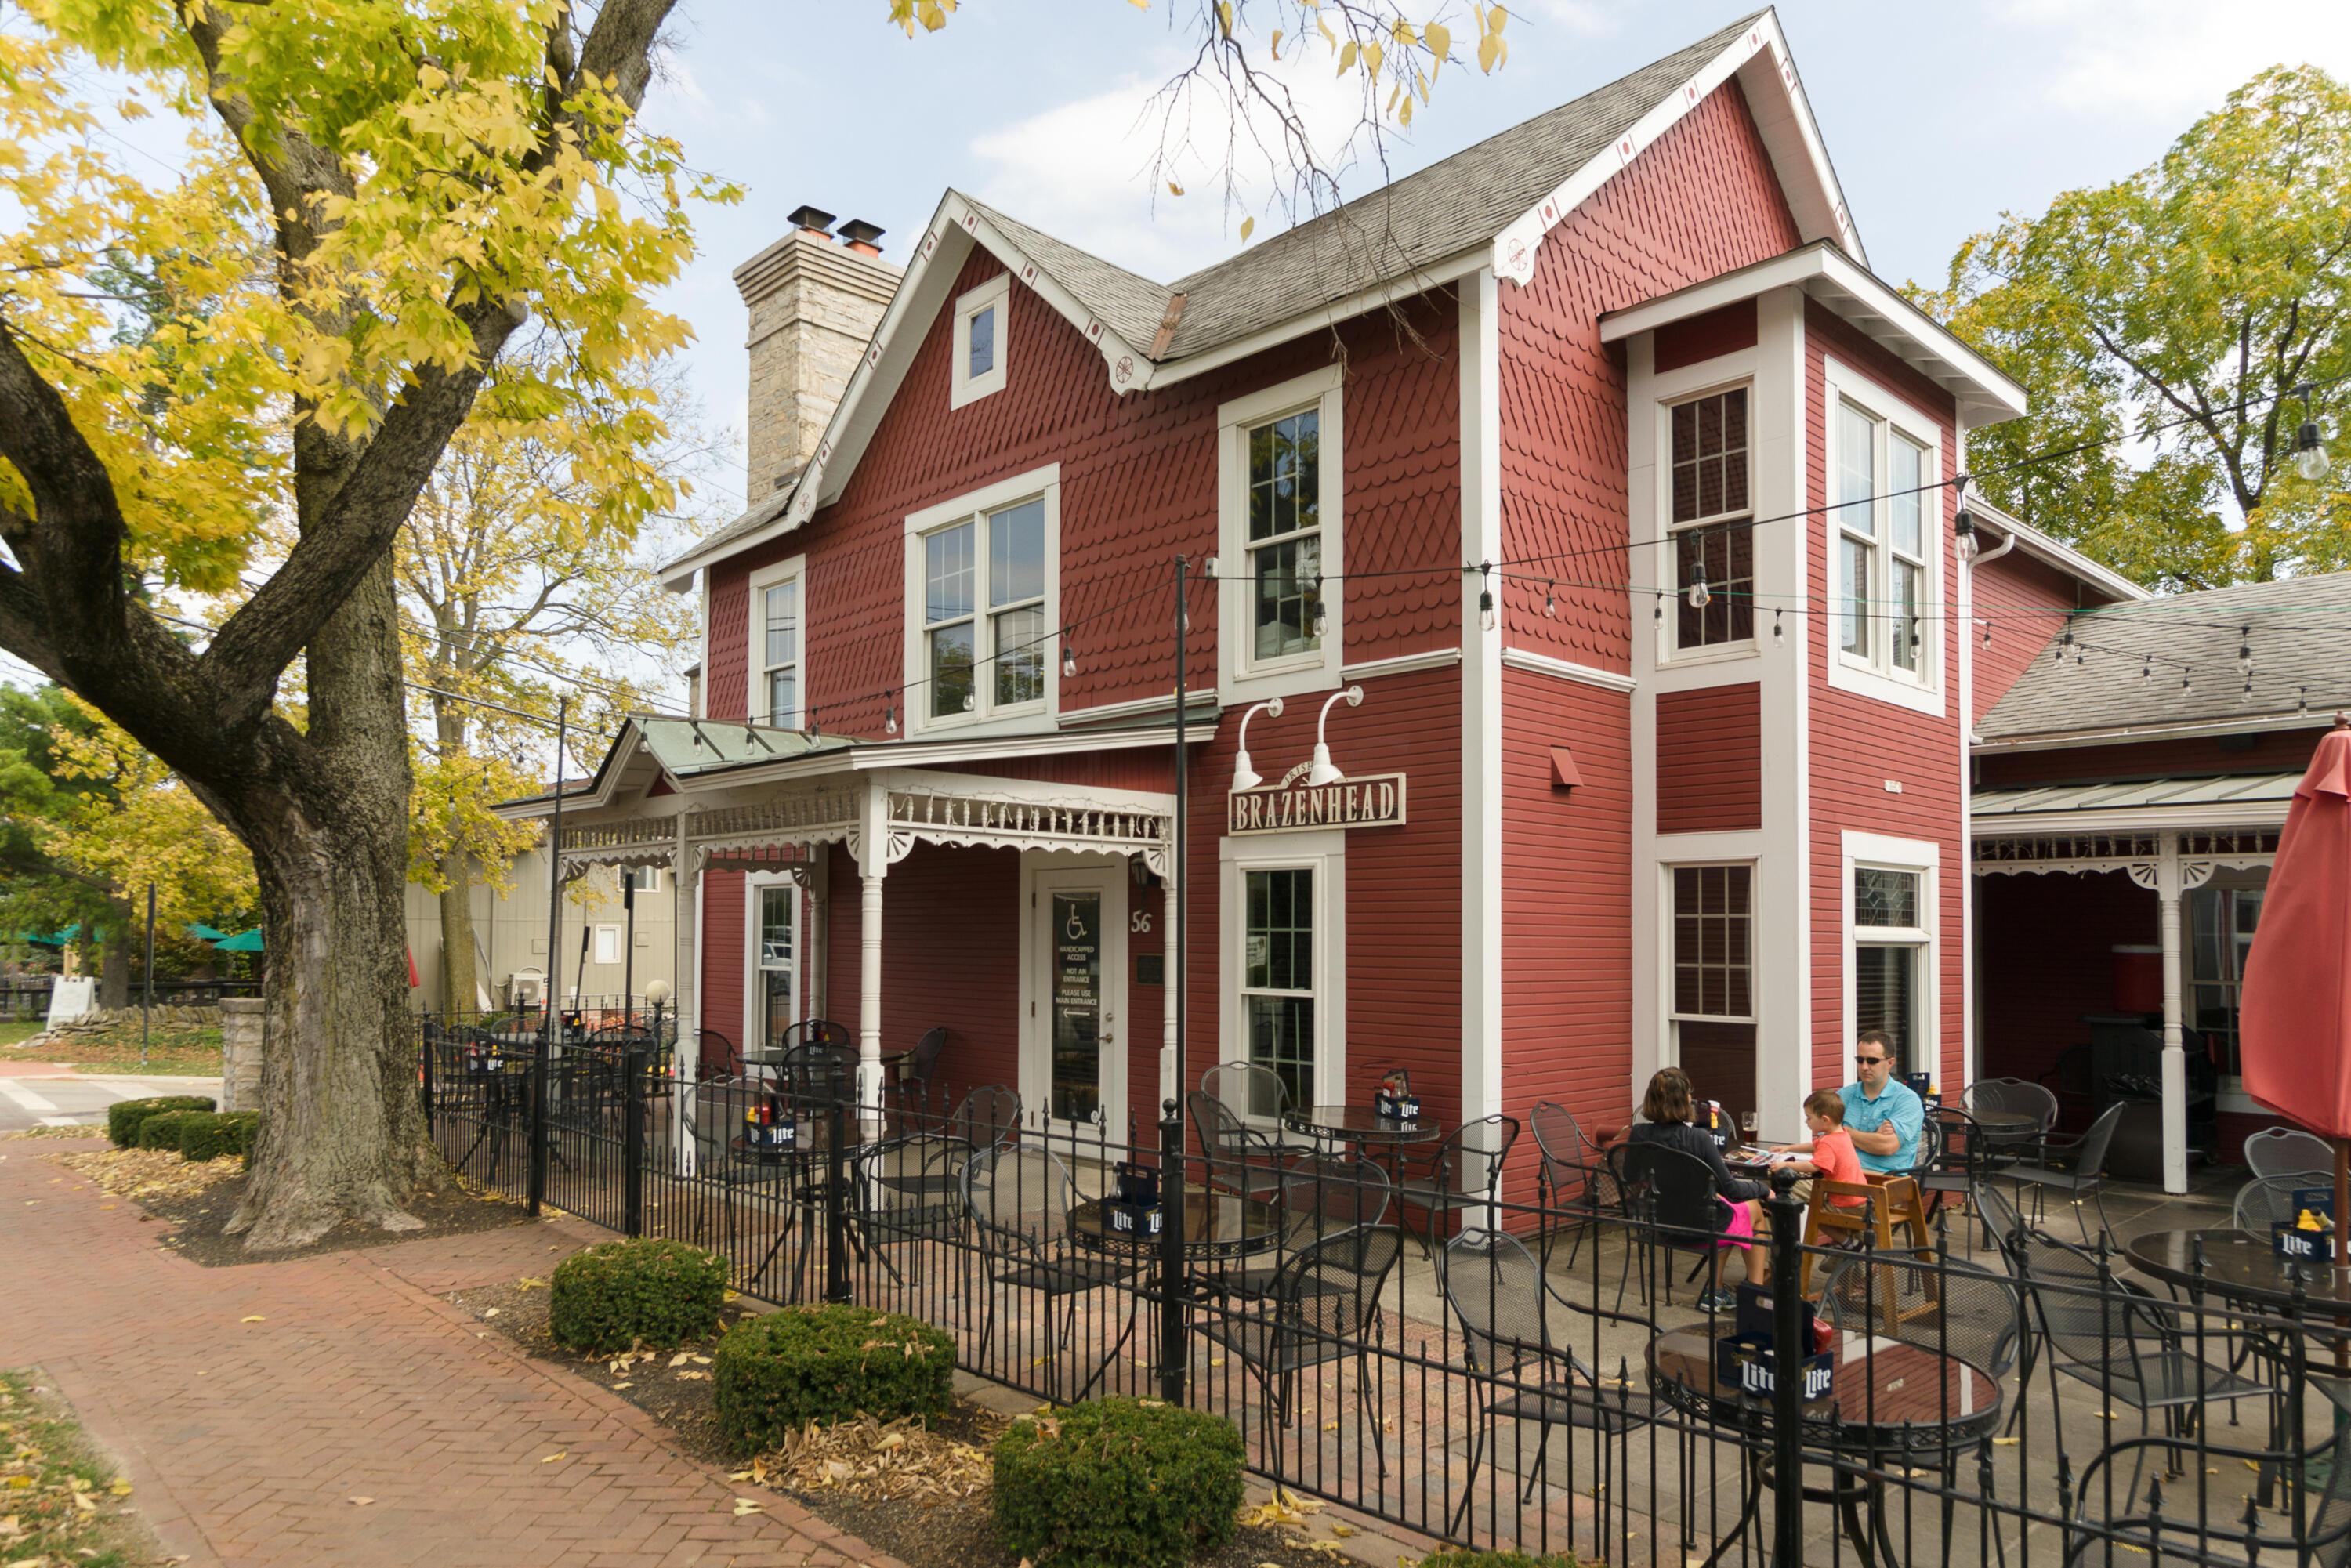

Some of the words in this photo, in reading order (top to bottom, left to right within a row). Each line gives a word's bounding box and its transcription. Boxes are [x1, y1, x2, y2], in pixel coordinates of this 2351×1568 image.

[1235, 782, 1394, 831] BRAZENHEAD
[1131, 910, 1153, 933] 56
[1400, 1103, 1419, 1117] Lite
[773, 1128, 795, 1144] Lite
[1113, 1210, 1133, 1231] Lite
[2282, 1233, 2313, 1255] Lite
[1805, 1368, 1831, 1399] Lite
